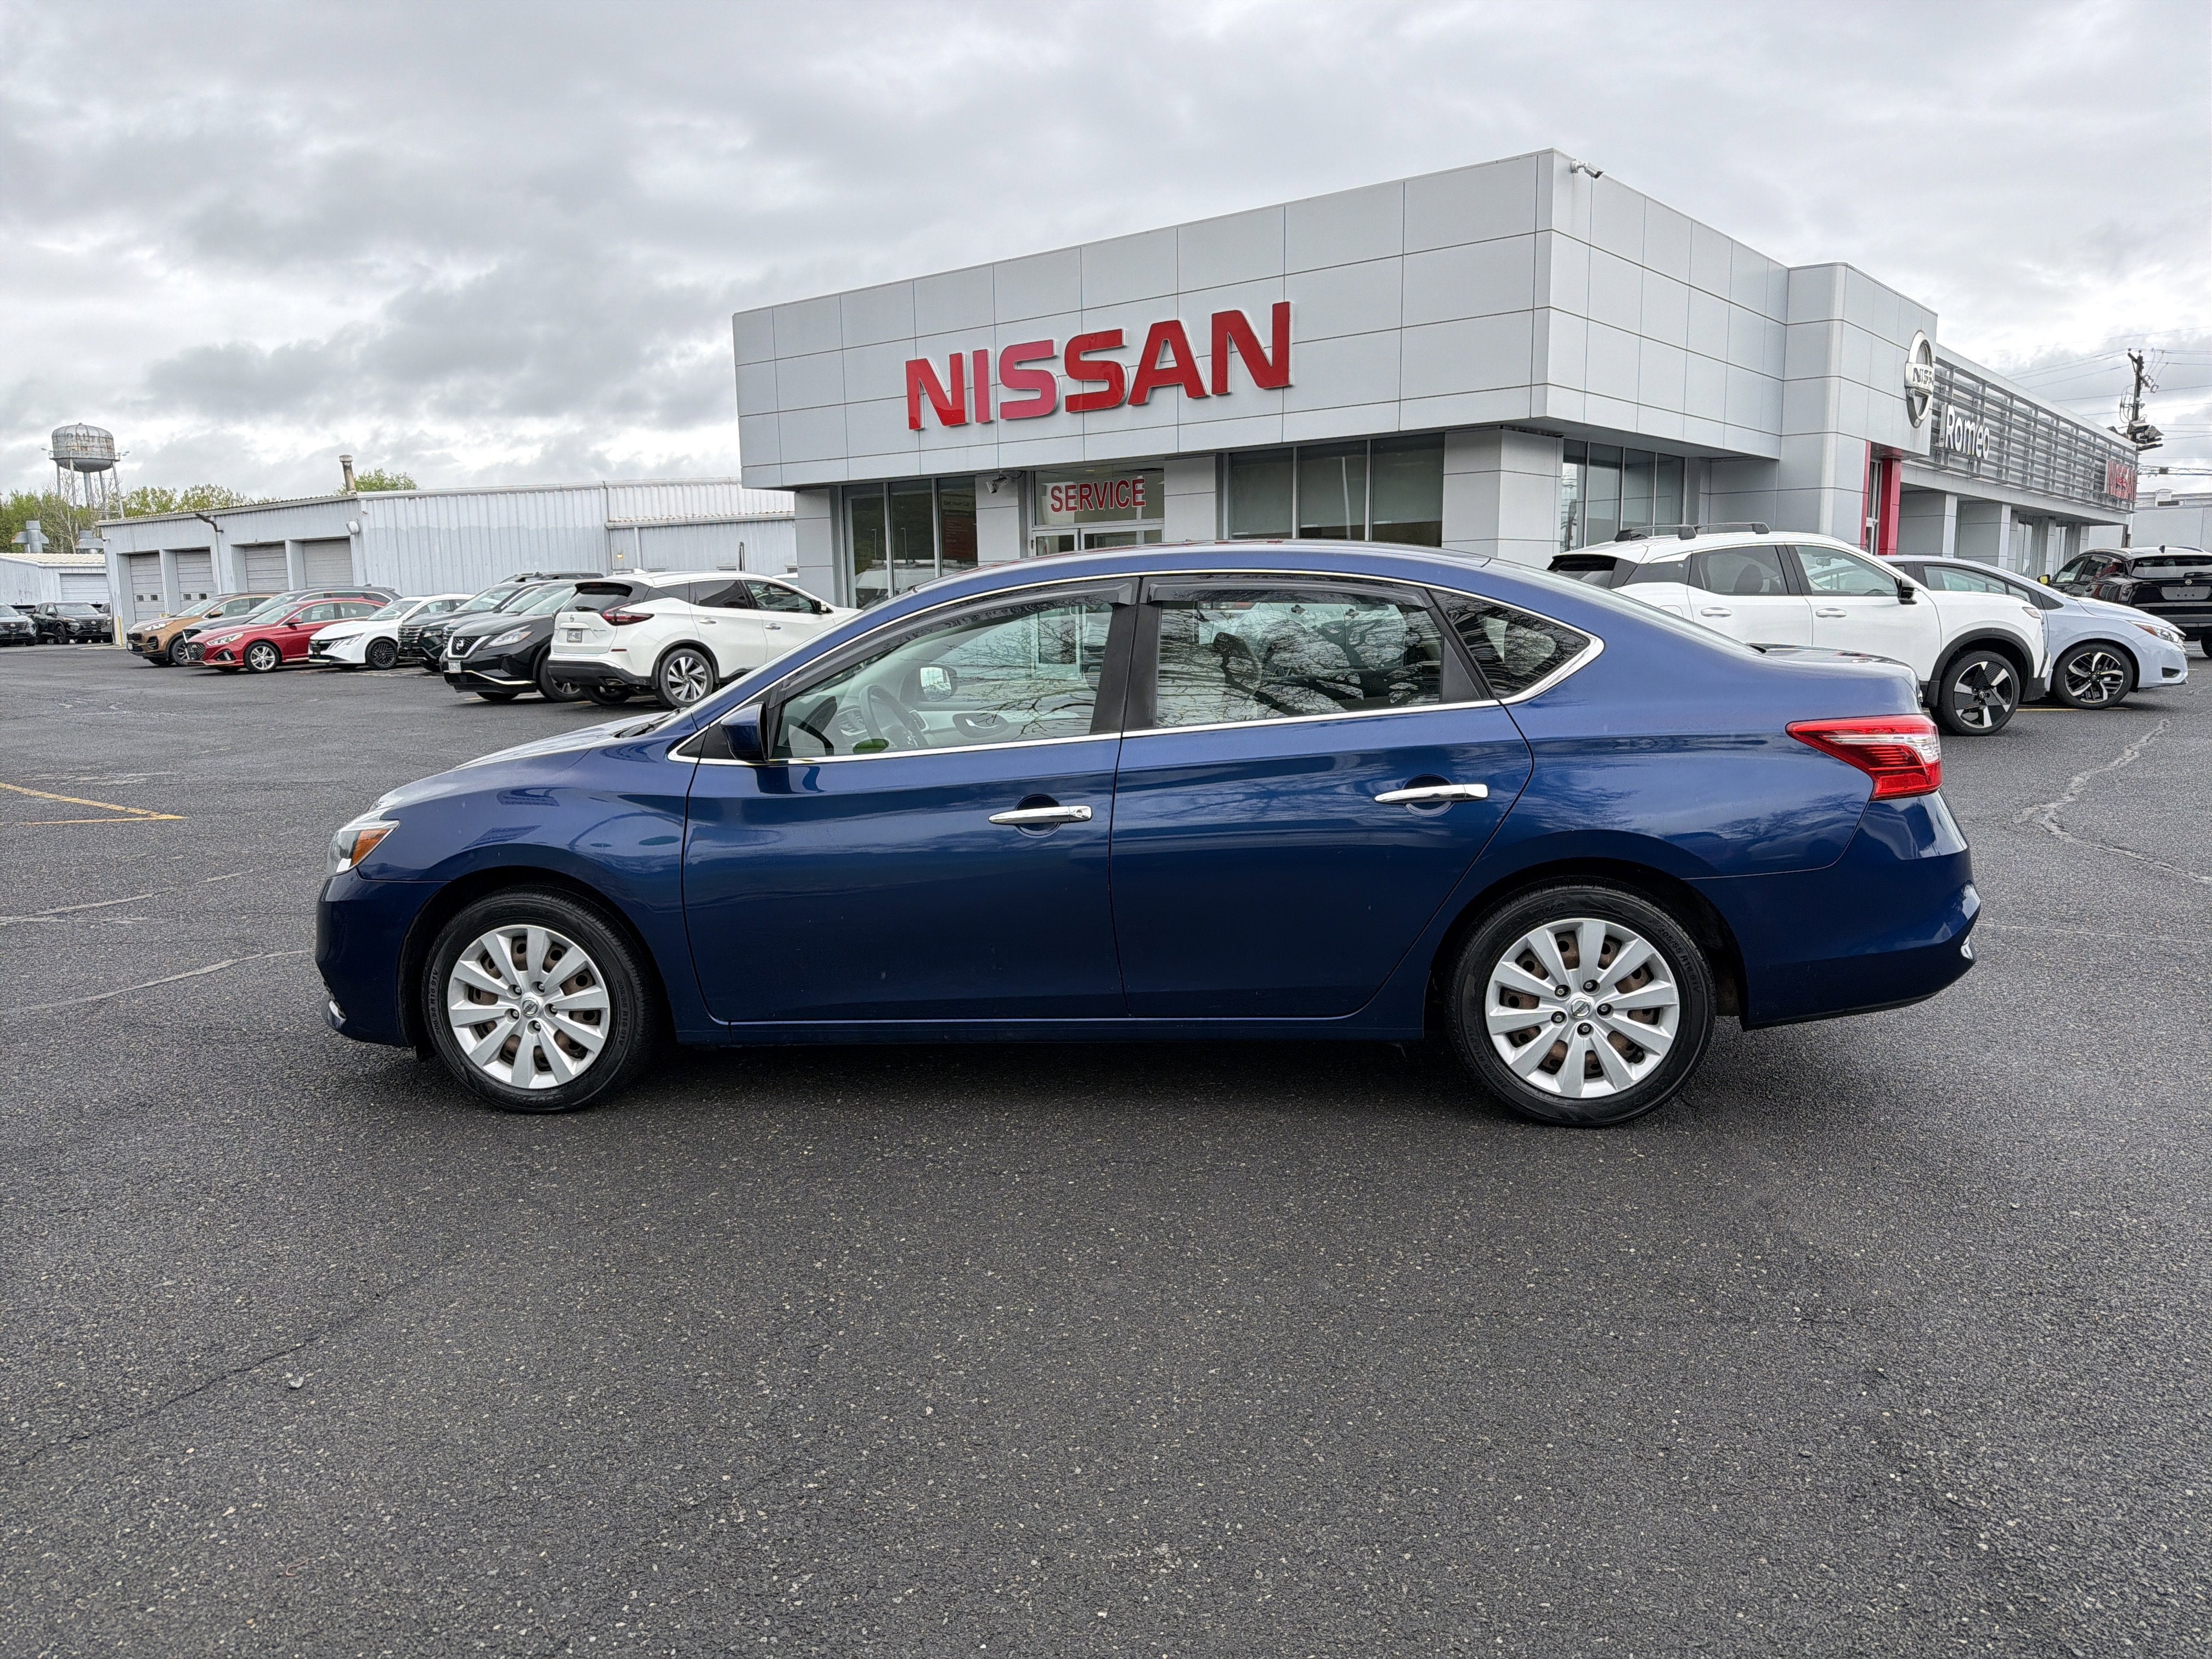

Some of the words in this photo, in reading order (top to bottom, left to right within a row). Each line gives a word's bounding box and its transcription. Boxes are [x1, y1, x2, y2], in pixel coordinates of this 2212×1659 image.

[905, 301, 1292, 430] NISSAN
[1912, 367, 1934, 386] NISS
[1945, 404, 1990, 460] Romeo
[1050, 477, 1147, 513] SERVICE
